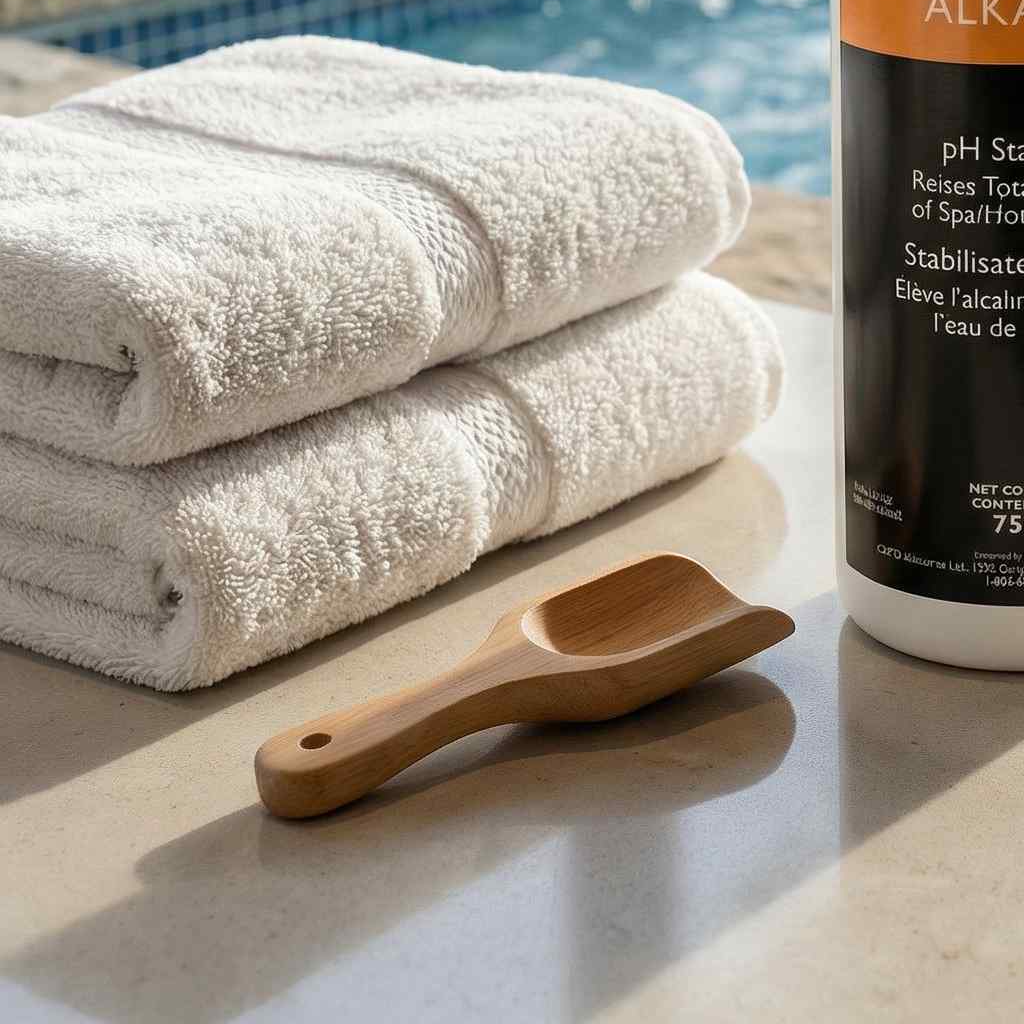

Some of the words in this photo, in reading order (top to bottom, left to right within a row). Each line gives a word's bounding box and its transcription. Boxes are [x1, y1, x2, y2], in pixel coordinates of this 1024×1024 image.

[943, 135, 980, 167] pH
[912, 169, 976, 196] Reises
[911, 199, 933, 220] of
[895, 274, 945, 306] Élève
[934, 312, 981, 337] l'eau
[989, 317, 1016, 338] de
[969, 482, 999, 495] NET
